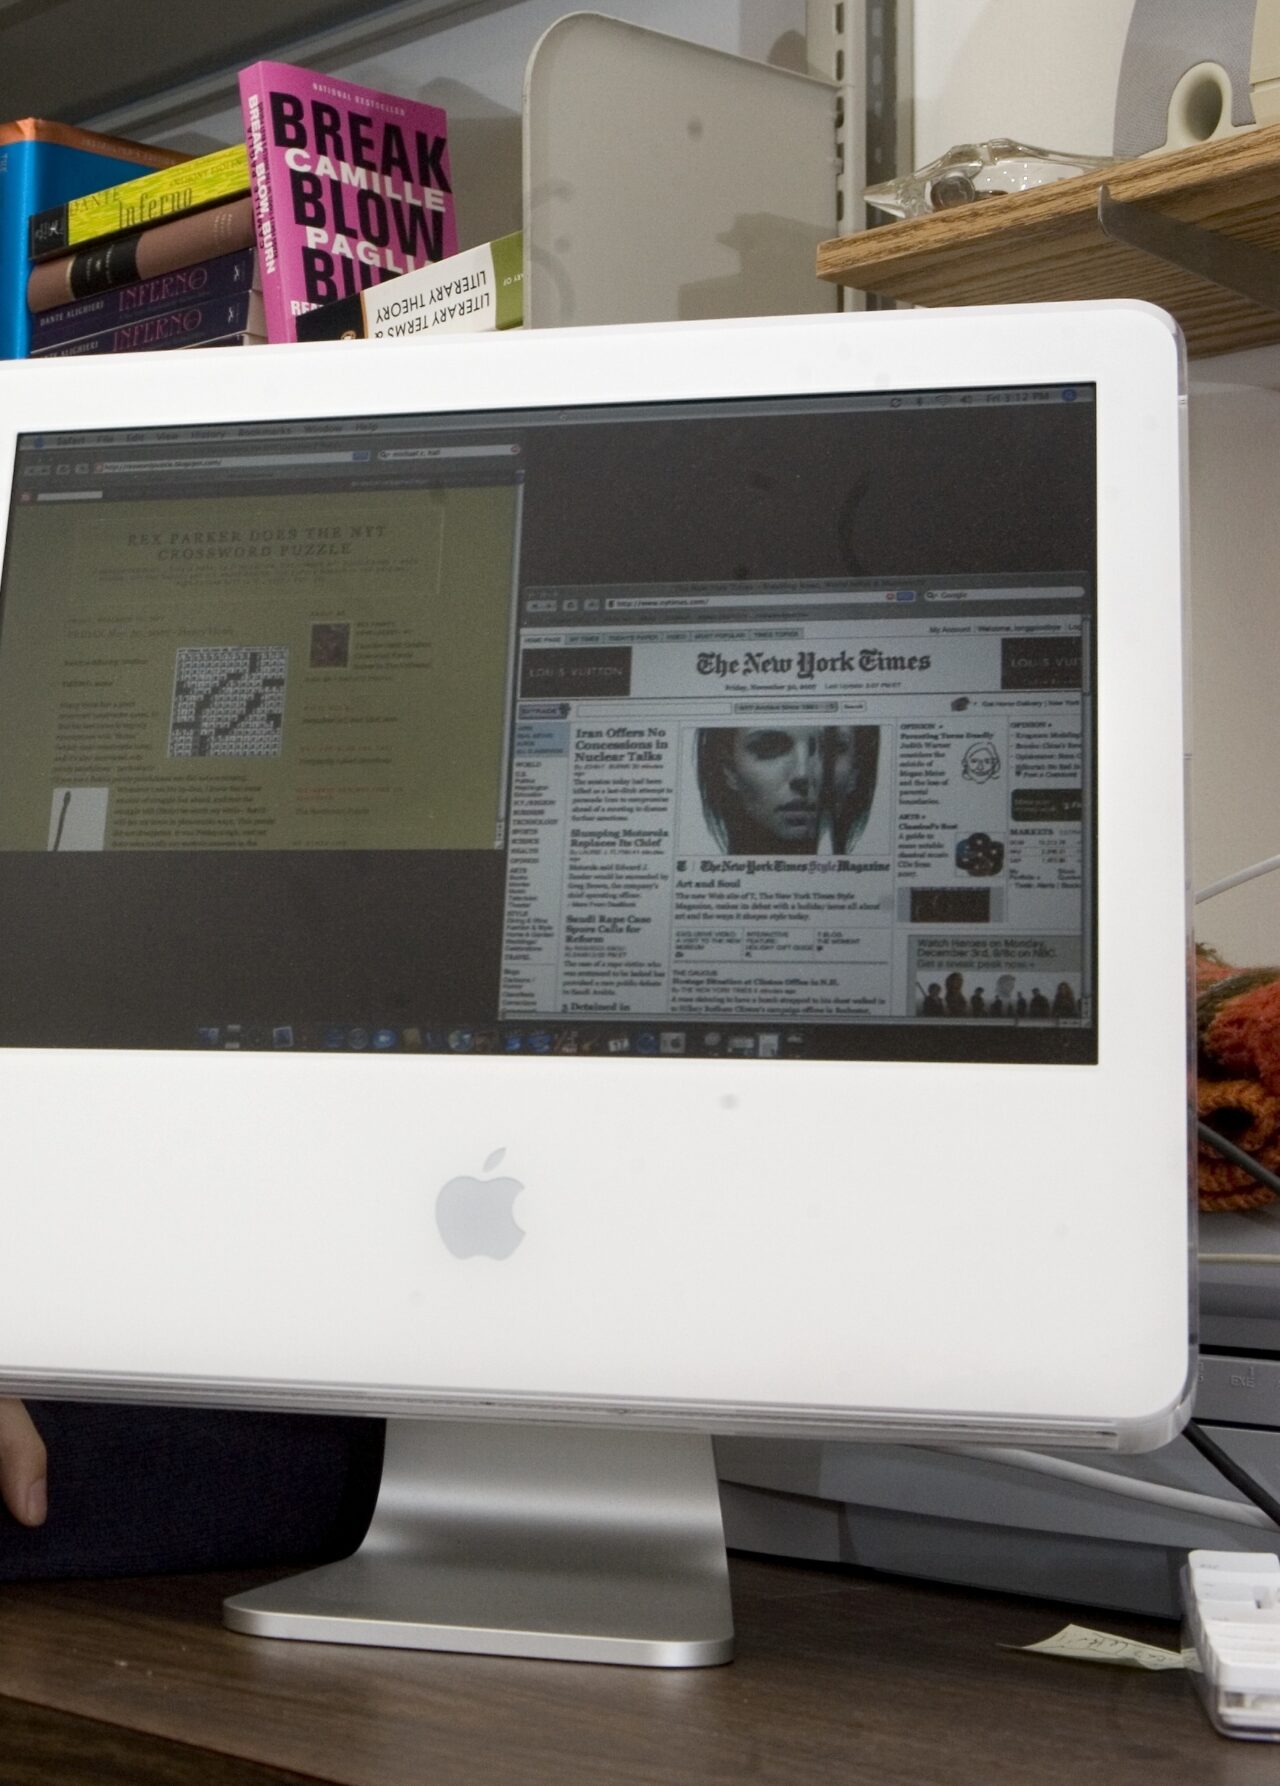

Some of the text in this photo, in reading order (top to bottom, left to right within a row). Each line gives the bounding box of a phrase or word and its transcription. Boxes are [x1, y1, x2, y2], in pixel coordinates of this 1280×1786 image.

[312, 82, 405, 116] NATIONAL BESTSELLER
[269, 91, 452, 194] BREAK
[247, 94, 263, 161] BREAK,
[255, 163, 269, 218] BLOW,
[262, 221, 276, 274] BURN
[284, 148, 446, 213] CAMILLE
[70, 187, 120, 215] DANTE
[120, 188, 193, 229] Inferno
[289, 168, 445, 263] BLOW
[306, 226, 433, 274] PAGLI
[119, 267, 208, 312] INFERNO
[375, 270, 488, 322] LITERARY THEORY
[40, 300, 104, 327] DANTE ALIGHIERI
[431, 292, 491, 328] LITERARY
[112, 309, 202, 353] INFERNO
[387, 314, 430, 338] TERMS
[61, 341, 99, 358] ALIGHIERI
[986, 393, 999, 402] Fri
[1032, 391, 1050, 401] PM
[126, 433, 144, 442] Edit
[156, 432, 178, 441] View
[191, 430, 226, 440] History
[304, 424, 343, 433] Window
[126, 525, 386, 546] REX PARKER DOES THE NYT
[158, 542, 353, 562] CROSSWORD PUZZLE
[696, 648, 931, 679] The New York Times
[576, 727, 667, 738] Iran Offers No
[575, 740, 669, 750] Concessions in
[574, 751, 663, 762] Nuclear Talks
[571, 828, 669, 839] Slumping Motorola
[1010, 828, 1054, 836] MARKETS
[570, 838, 662, 848] Replaces Its Chief
[700, 861, 721, 873] The
[722, 861, 746, 873] New
[746, 861, 774, 875] York
[774, 861, 807, 873] Times
[808, 862, 837, 875] Style
[837, 860, 890, 874] Magazine
[676, 879, 741, 888] Art and Soul
[566, 914, 651, 926] Saudi Rape Case
[598, 924, 623, 933] Calls
[626, 925, 641, 934] for
[566, 935, 604, 944] Reform
[918, 939, 949, 948] Watch
[951, 939, 987, 948] Heroes
[1004, 938, 1045, 949] Monday,
[917, 949, 968, 958] December
[917, 959, 936, 968] Get
[946, 959, 974, 968] sneak
[977, 959, 1001, 970] peek
[1004, 960, 1025, 968] now
[706, 977, 742, 986] Situation
[754, 978, 783, 986] Clinton
[785, 978, 809, 986] Office
[571, 1002, 617, 1011] Detained
[619, 1002, 630, 1011] in
